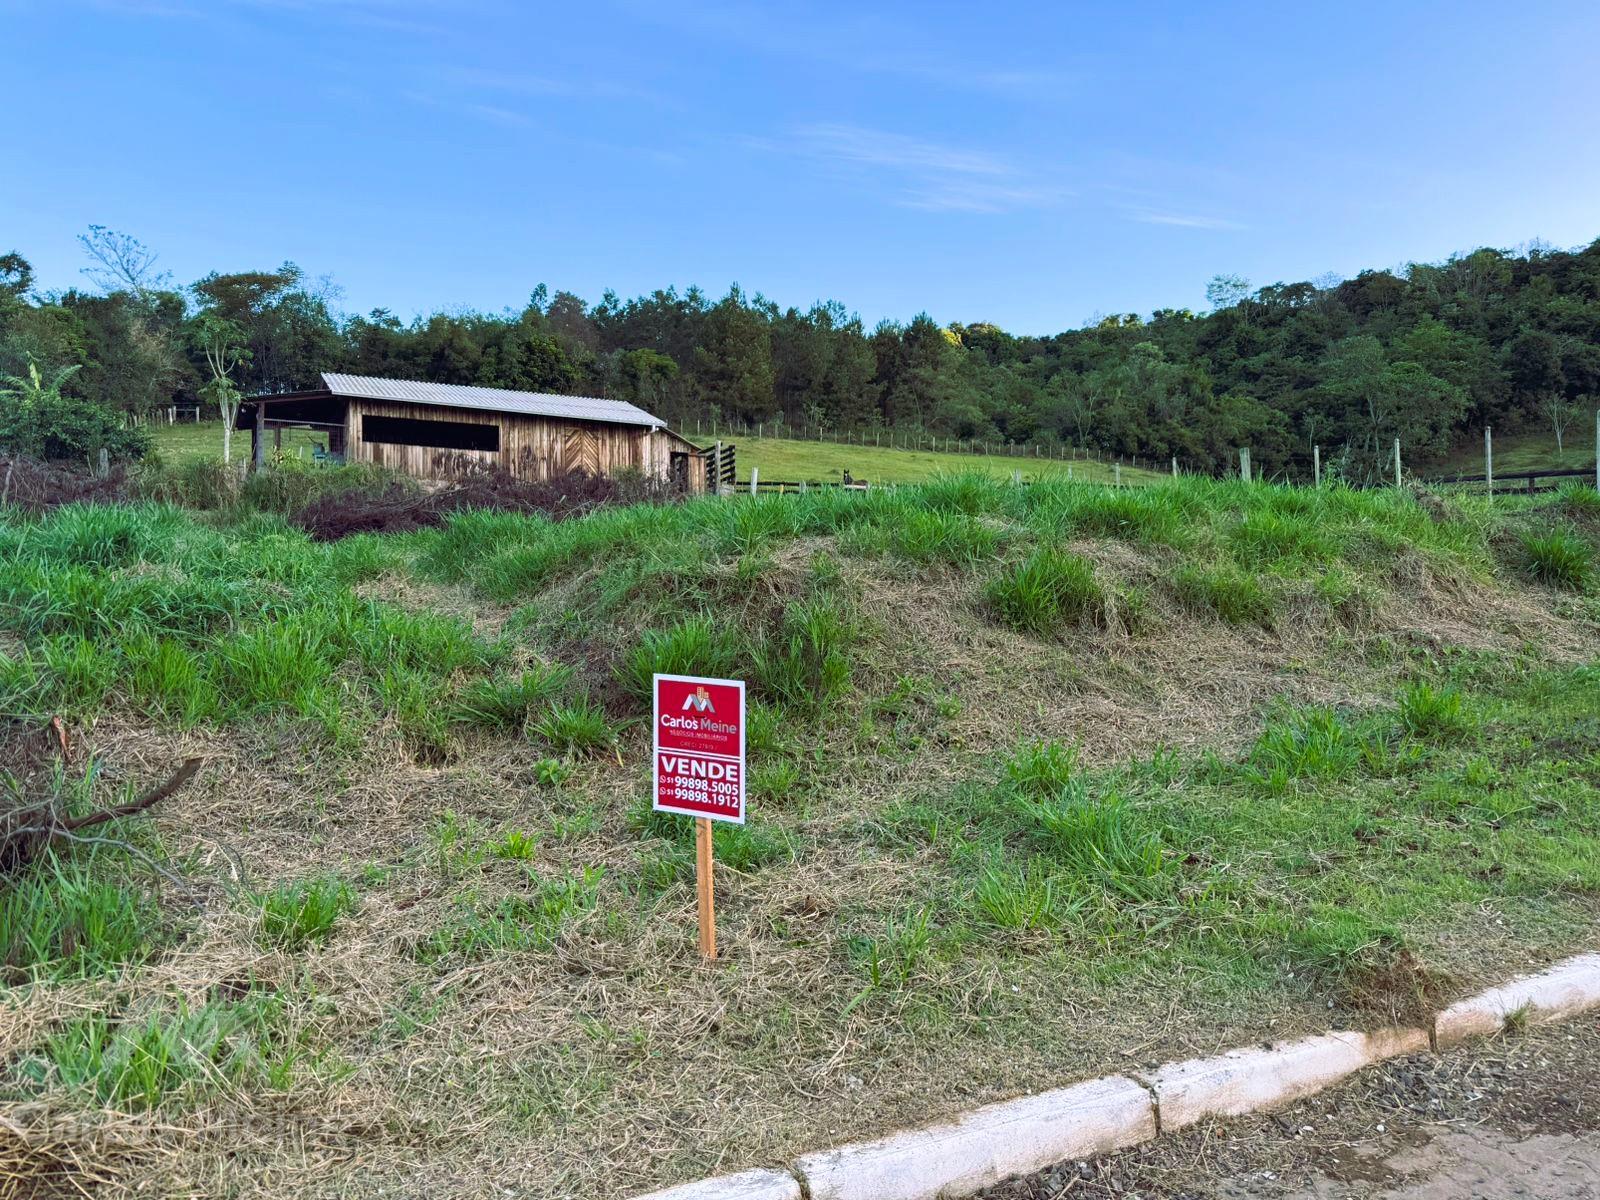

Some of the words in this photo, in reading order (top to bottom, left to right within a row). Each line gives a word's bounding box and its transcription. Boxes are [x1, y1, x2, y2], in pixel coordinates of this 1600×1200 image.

[661, 714, 698, 730] Carlos
[700, 719, 737, 734] Meine
[661, 755, 738, 782] VENDE
[666, 776, 674, 784] 51
[674, 775, 739, 796] 99898.5005
[674, 787, 739, 808] 99898.1912
